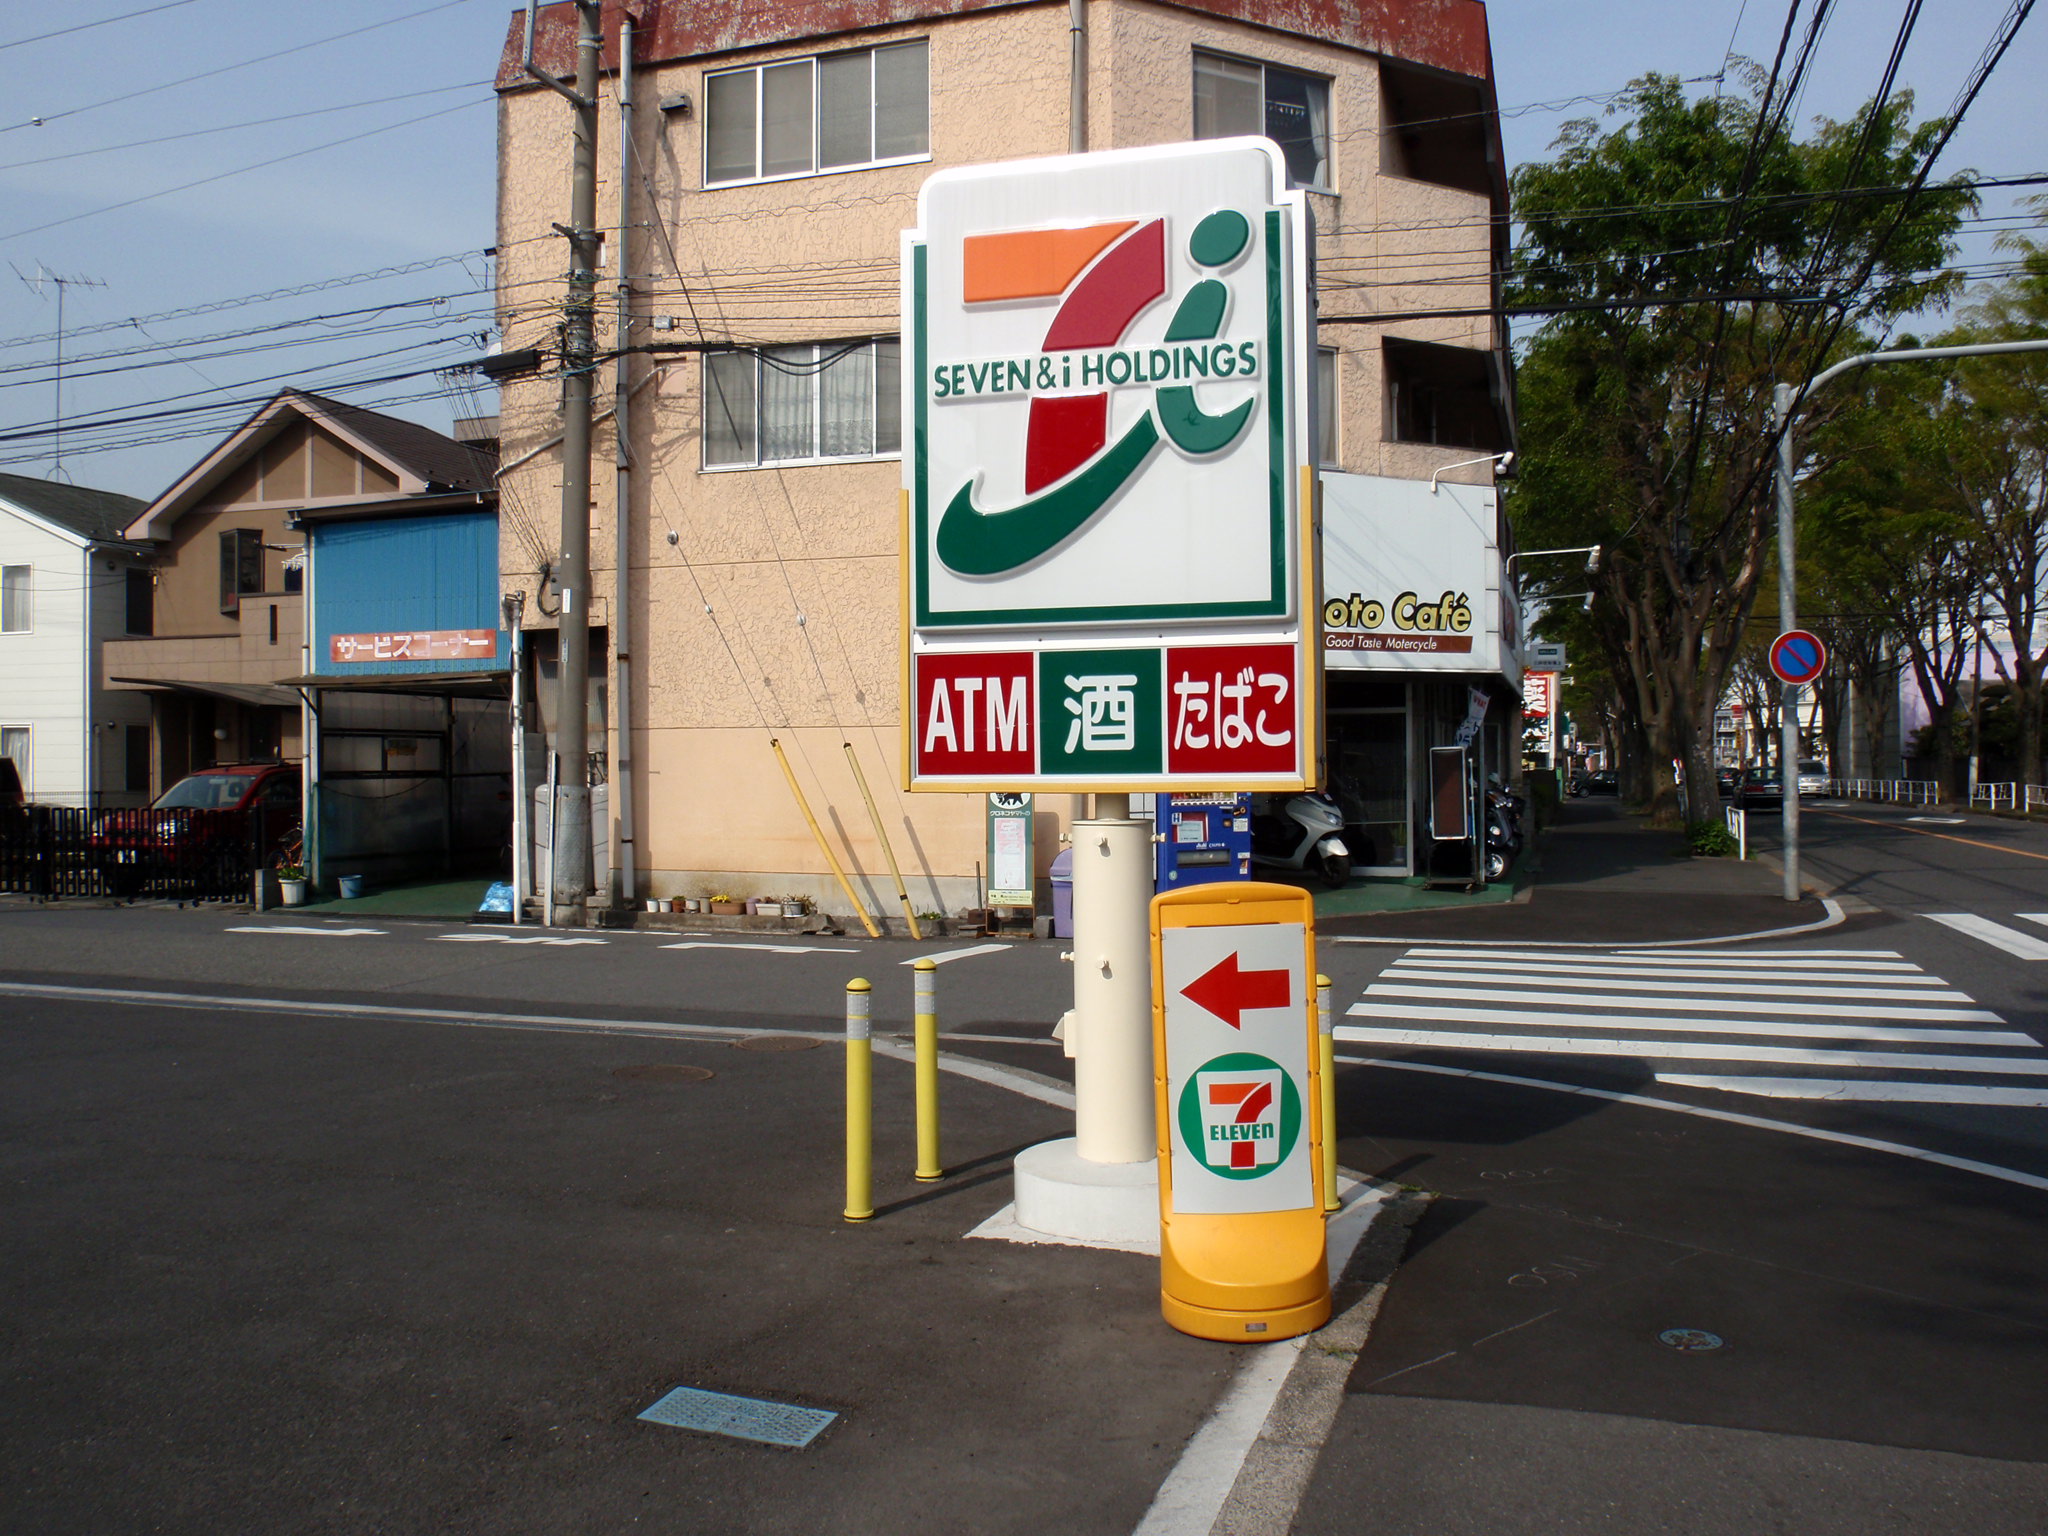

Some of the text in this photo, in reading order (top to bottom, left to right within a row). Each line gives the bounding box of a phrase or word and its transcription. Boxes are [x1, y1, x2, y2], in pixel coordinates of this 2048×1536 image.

[1082, 340, 1257, 387] HOLDINGS
[1391, 590, 1472, 632] Café
[336, 633, 489, 659] サービスコーナー
[1325, 634, 1438, 653] Good Taste Motercycle
[923, 676, 1028, 753] ATM
[1063, 674, 1138, 755] 酒
[1173, 665, 1292, 751] たばこ
